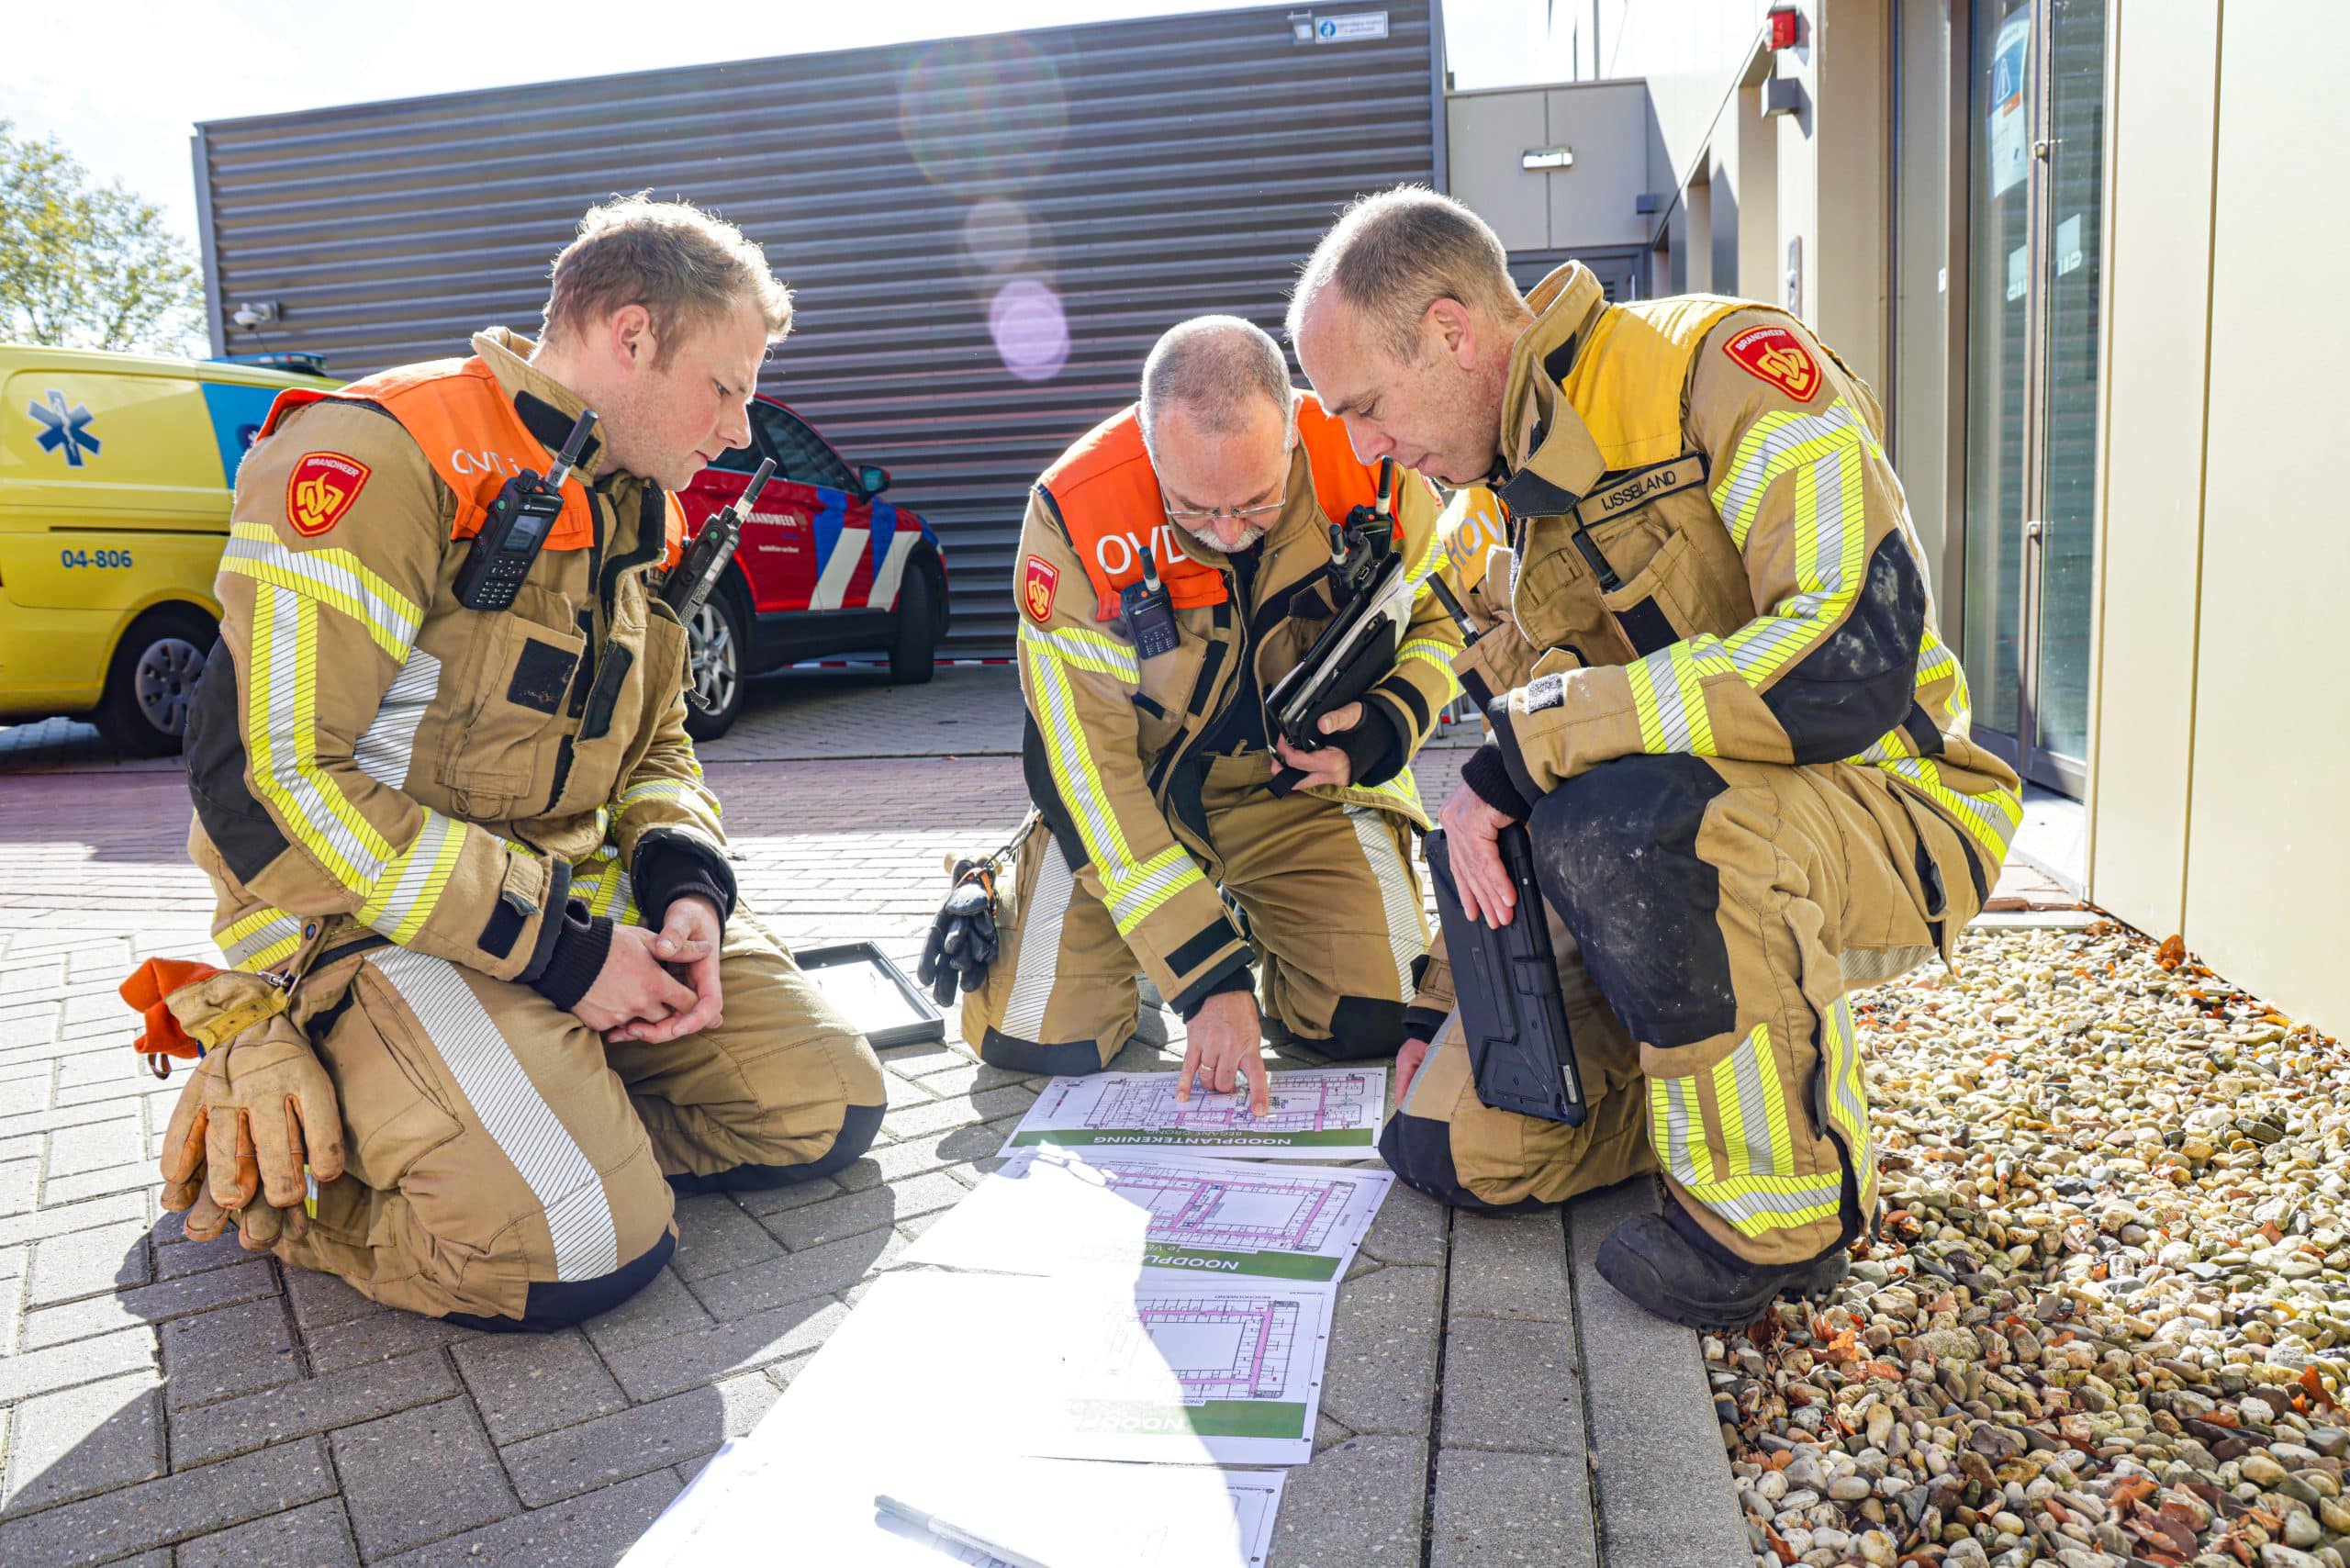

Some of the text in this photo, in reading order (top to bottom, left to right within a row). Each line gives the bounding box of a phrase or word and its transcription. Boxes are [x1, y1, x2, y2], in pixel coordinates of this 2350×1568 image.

[1735, 330, 1786, 351] BRANDWEER
[307, 458, 361, 477] BRANDWEER
[1601, 470, 1676, 511] IJSSELLAND
[61, 549, 133, 568] 04-806
[1093, 1136, 1292, 1146] NOODPLANTEKENING
